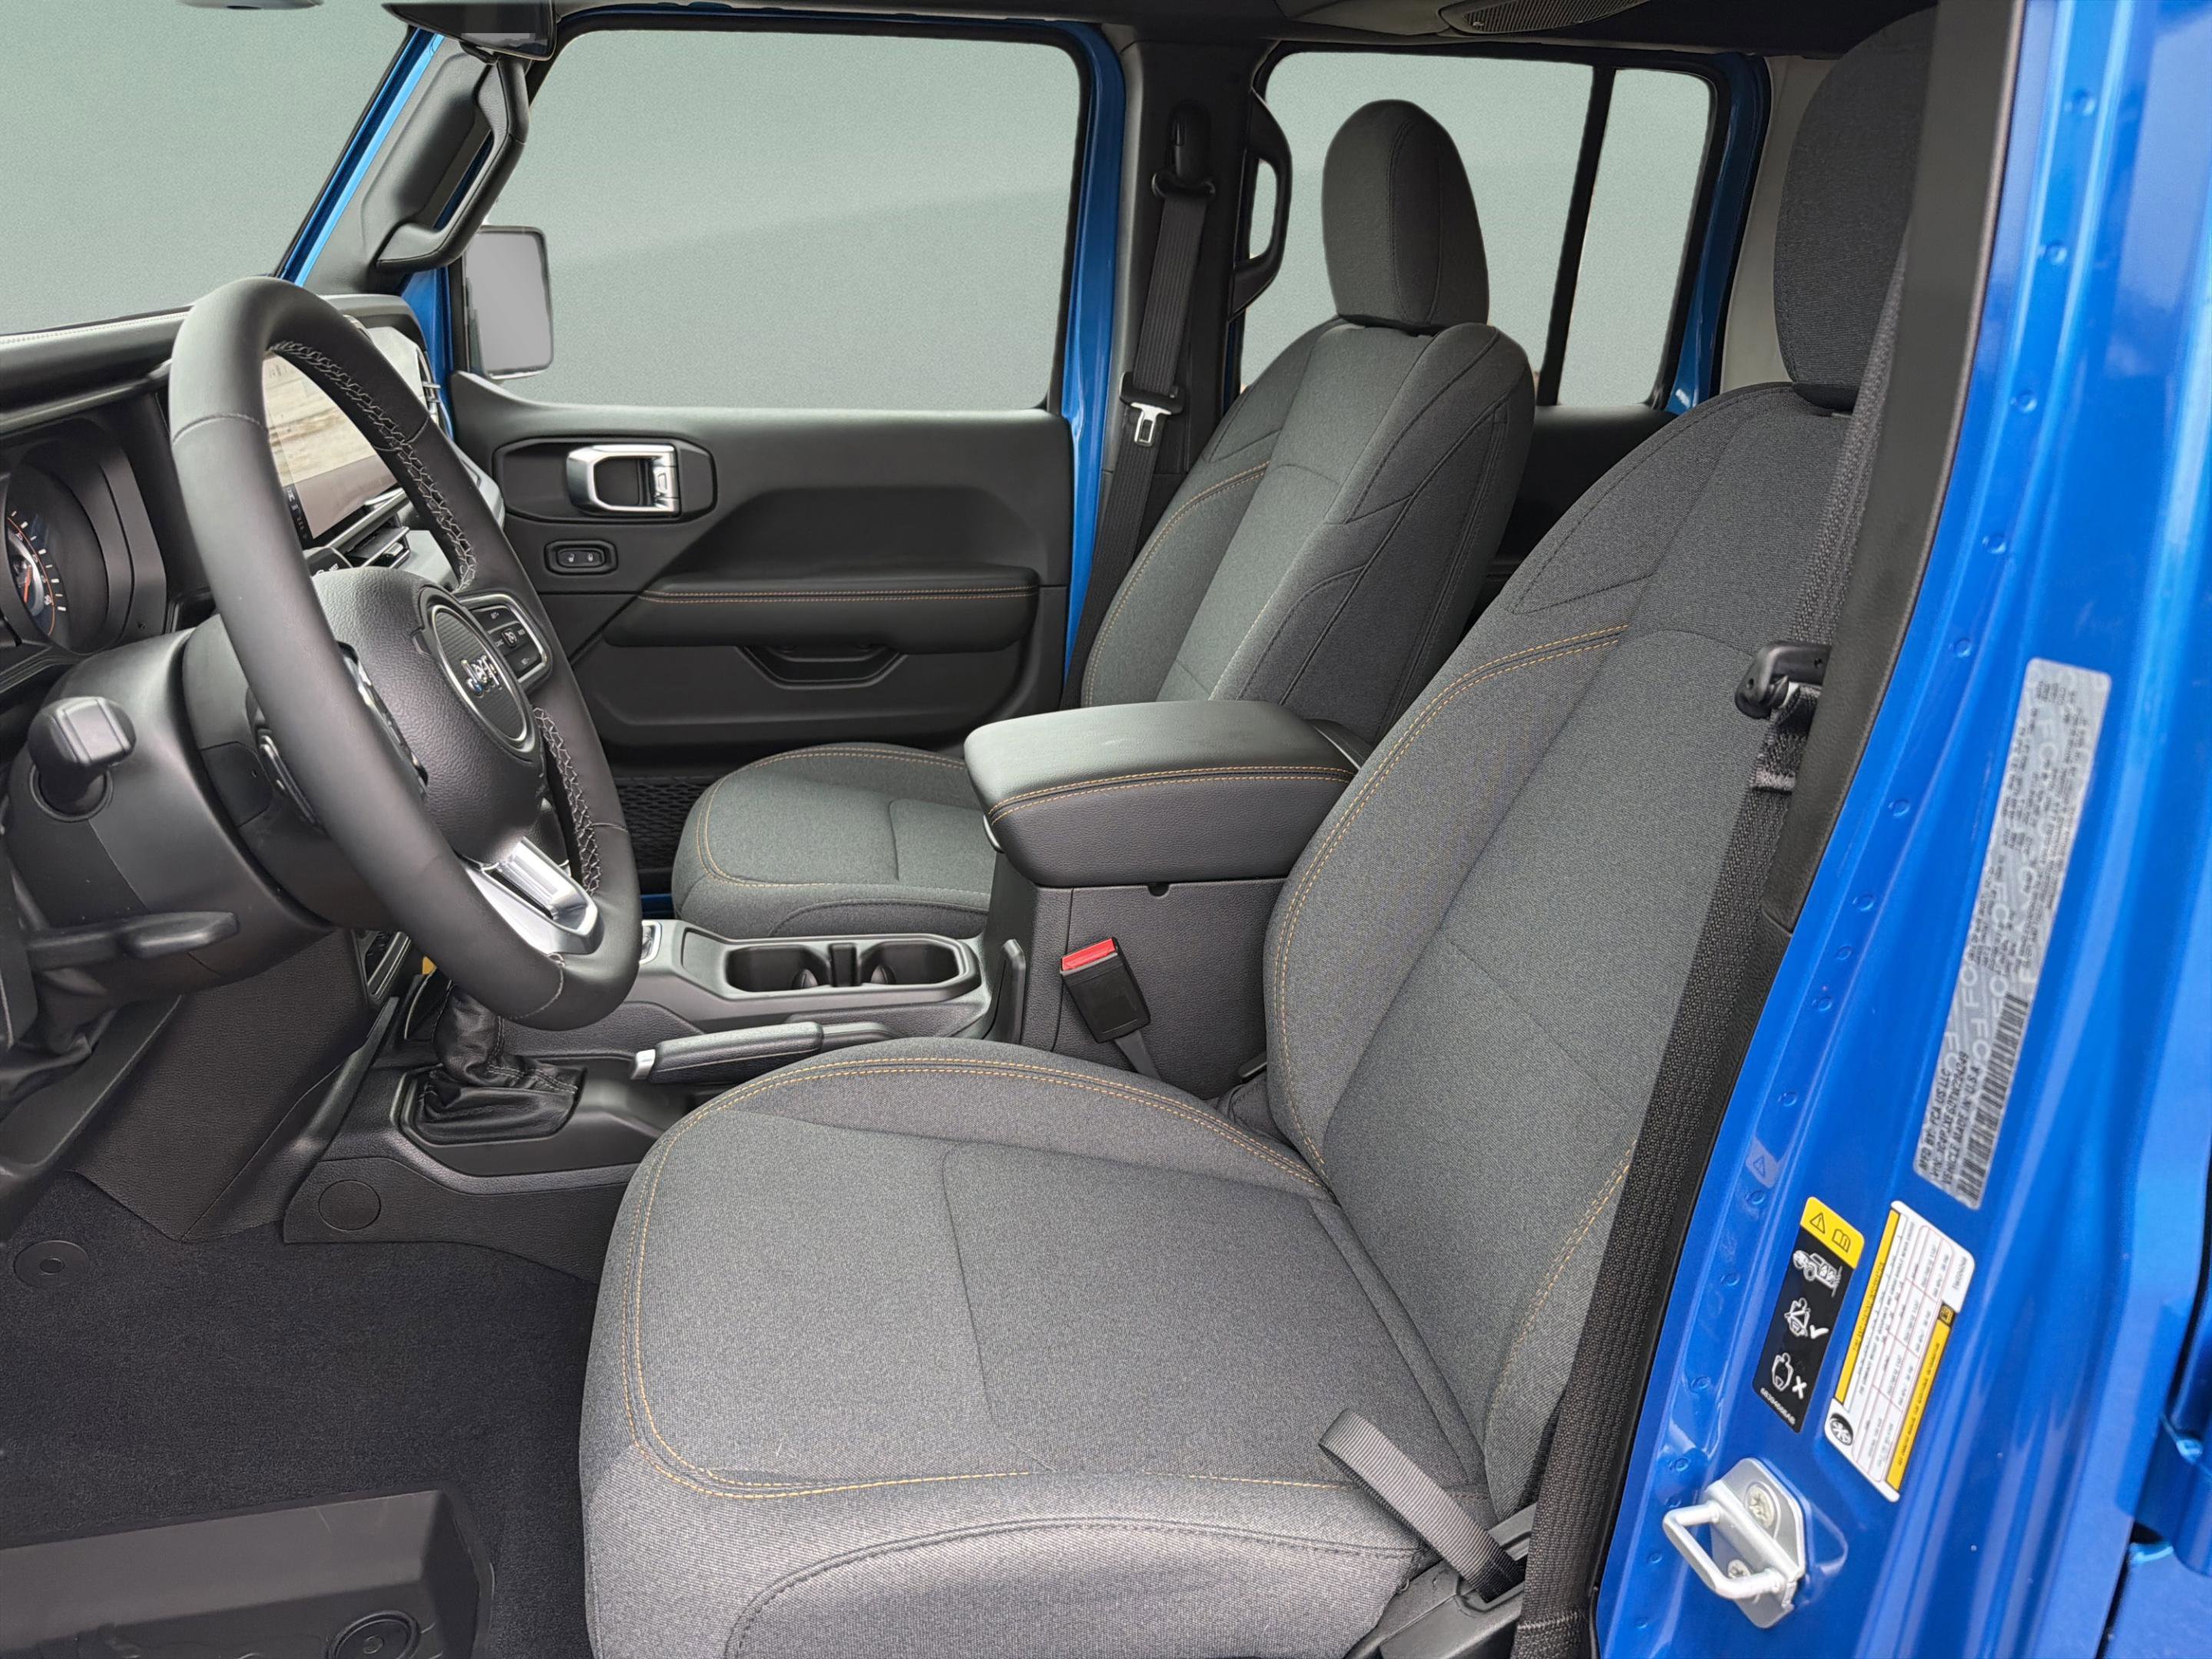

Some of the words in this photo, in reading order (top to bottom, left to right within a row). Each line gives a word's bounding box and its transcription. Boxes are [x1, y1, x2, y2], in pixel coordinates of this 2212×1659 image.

[460, 654, 500, 693] Jeep
[1938, 1066, 1951, 1088] LLC
[1934, 1088, 1945, 1104] US
[1929, 1104, 1942, 1126] FCA
[1941, 1142, 1960, 1187] VEHICLE
[1952, 1111, 1968, 1144] MADE
